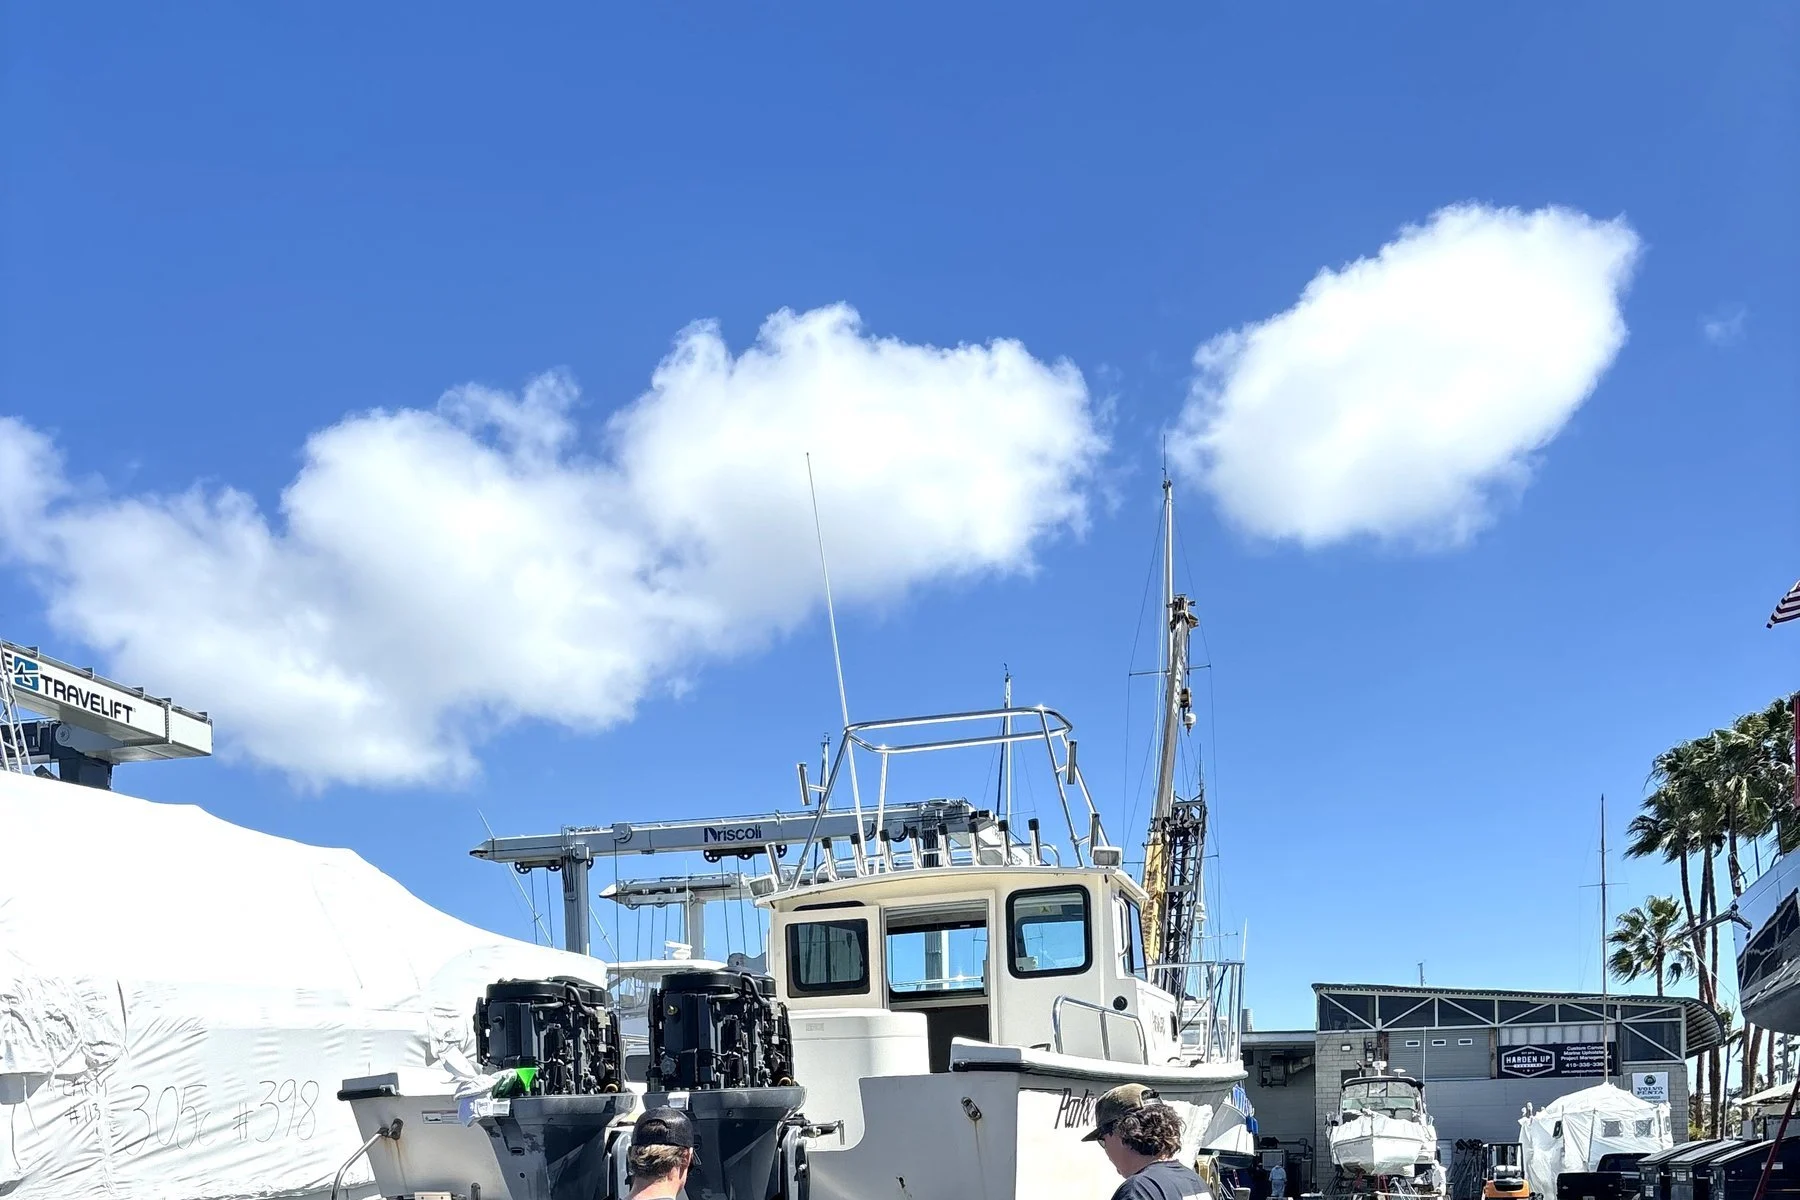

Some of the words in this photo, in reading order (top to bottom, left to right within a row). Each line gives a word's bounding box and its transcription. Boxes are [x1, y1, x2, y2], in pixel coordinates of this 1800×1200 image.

[40, 673, 133, 723] TRAVELIFT
[1506, 1056, 1538, 1064] HARDEN
[1540, 1055, 1551, 1063] UP
